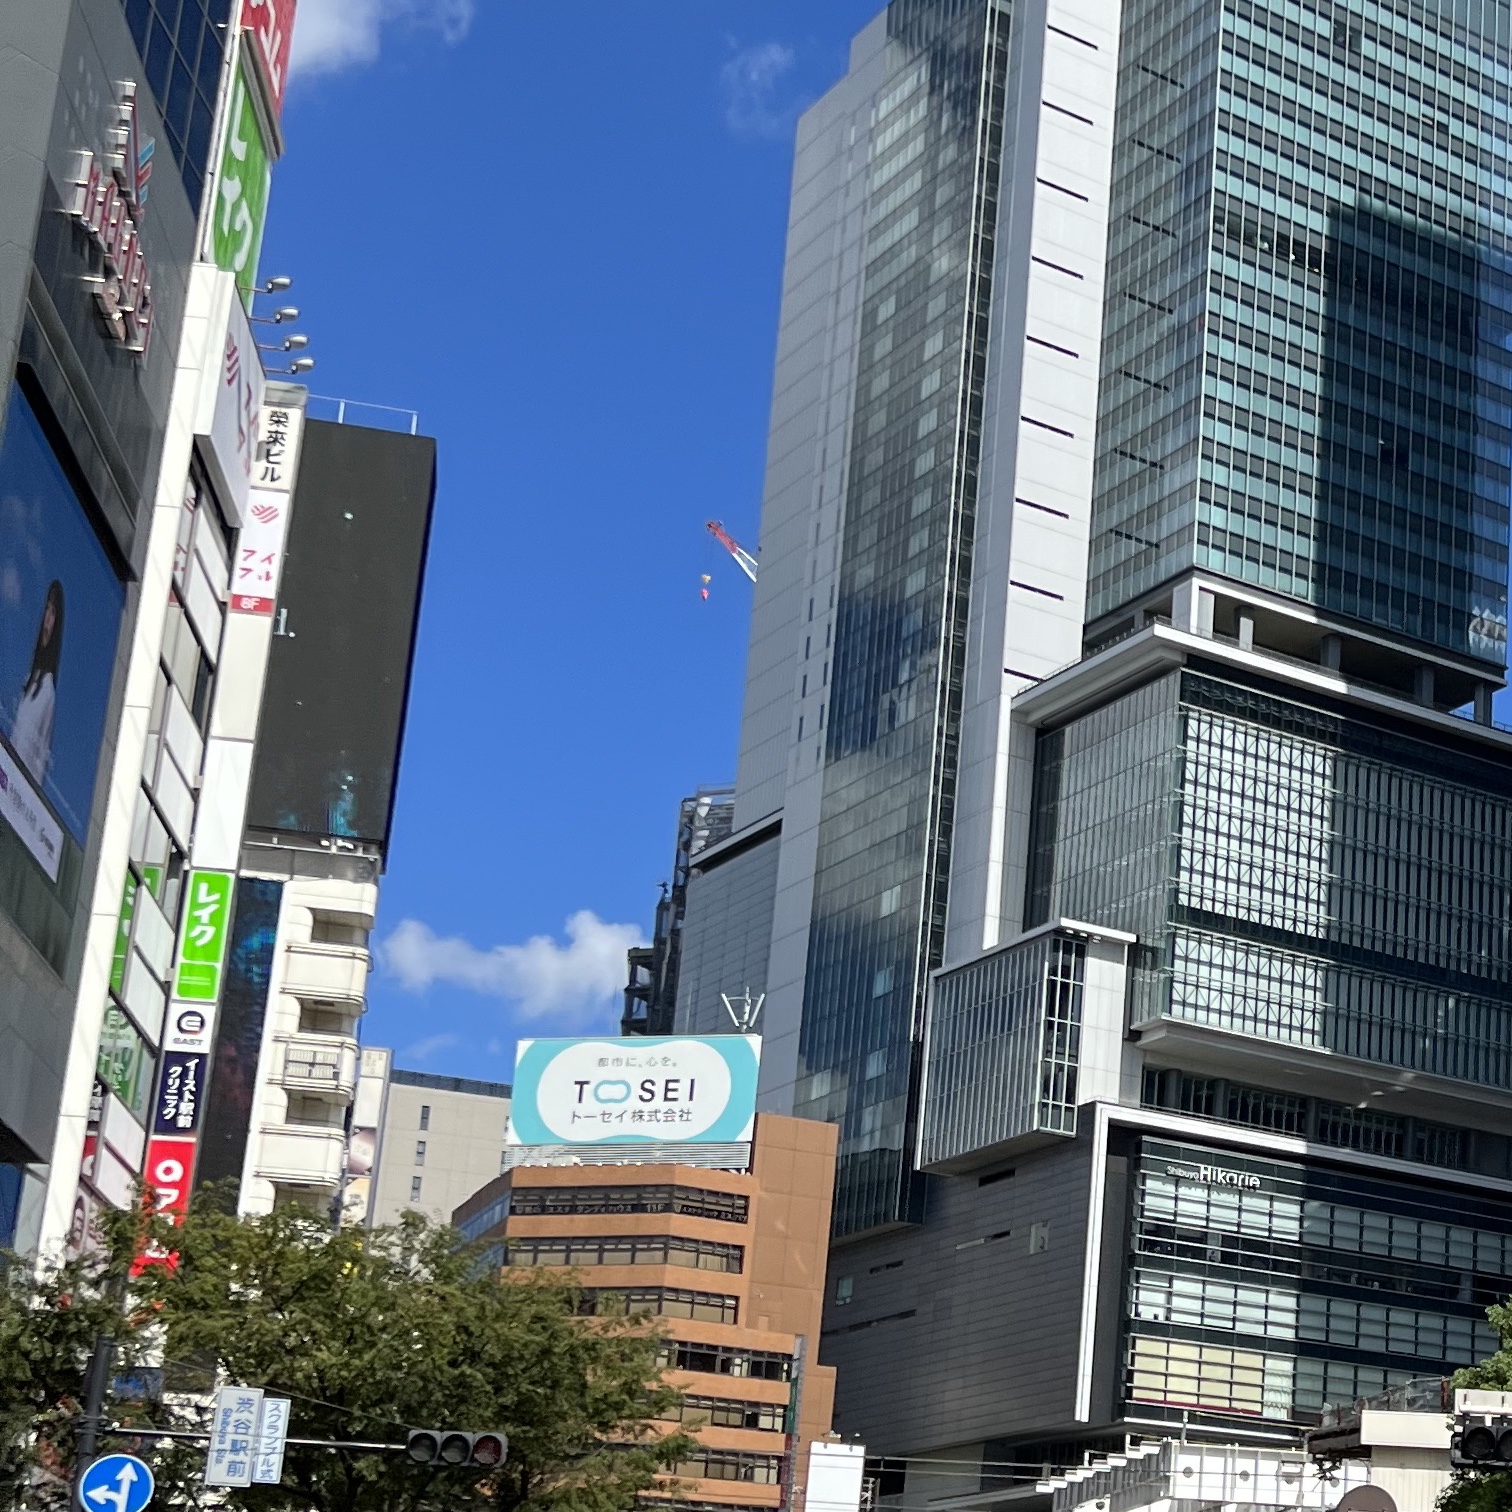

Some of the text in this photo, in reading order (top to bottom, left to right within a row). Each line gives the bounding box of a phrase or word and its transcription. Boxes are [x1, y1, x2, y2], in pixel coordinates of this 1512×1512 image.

[189, 882, 221, 947] レイク
[162, 1066, 183, 1121] クリニック
[176, 1058, 200, 1129] イースト駅前
[571, 1108, 692, 1124] トーセイ株式会社
[574, 1078, 696, 1103] TOSEI
[1166, 1164, 1261, 1188] Shibuya Hikarie
[226, 1396, 255, 1478] 渋谷駅前
[260, 1402, 282, 1480] スクランブル式
